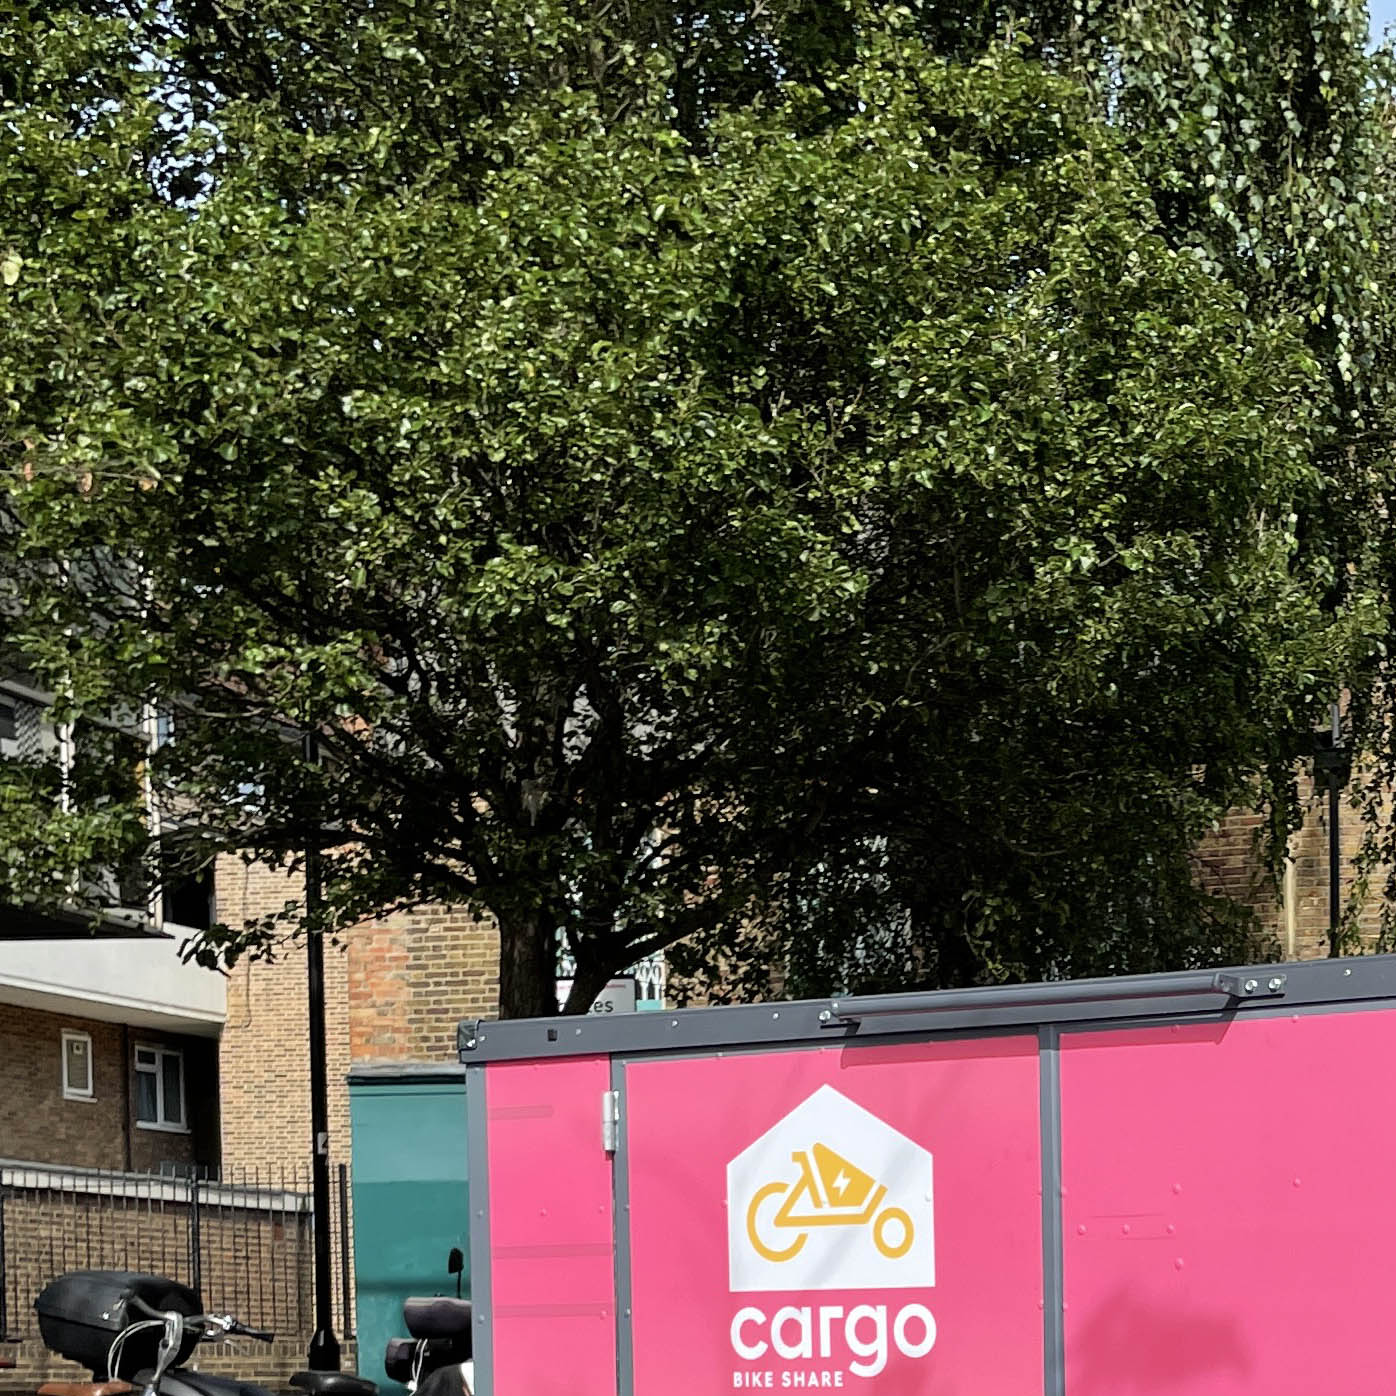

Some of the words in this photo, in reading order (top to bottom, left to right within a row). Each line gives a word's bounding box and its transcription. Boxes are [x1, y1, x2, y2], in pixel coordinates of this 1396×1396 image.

[730, 1303, 937, 1378] cargo
[732, 1371, 774, 1388] BIKE
[781, 1370, 844, 1388] SHARE
